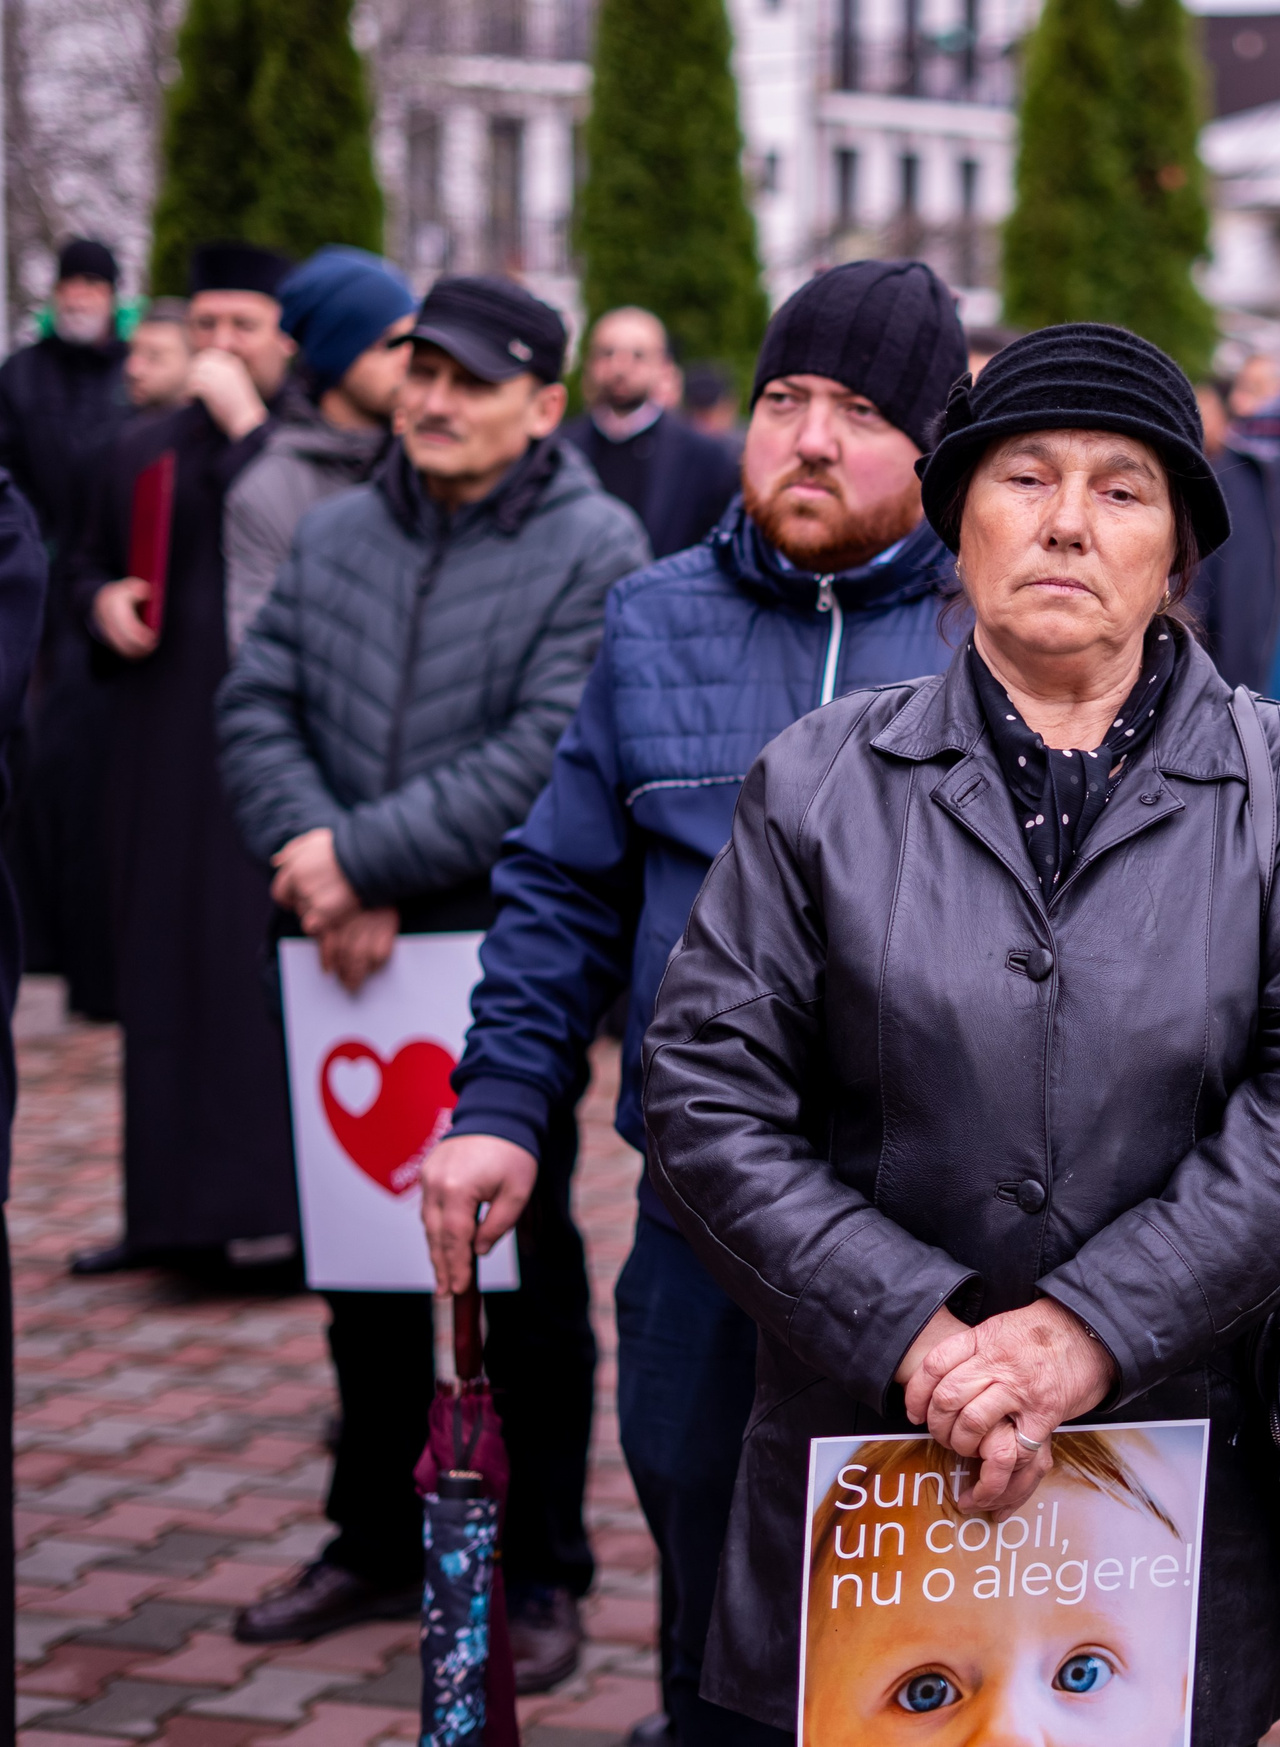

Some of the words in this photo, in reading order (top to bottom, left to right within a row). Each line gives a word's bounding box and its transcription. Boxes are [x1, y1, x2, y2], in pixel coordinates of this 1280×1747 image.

[834, 1464, 970, 1510] Sunt
[834, 1520, 906, 1559] un
[925, 1501, 1070, 1561] copil,
[831, 1570, 903, 1609] nu
[921, 1567, 956, 1602] o
[972, 1542, 1194, 1605] alegere!
